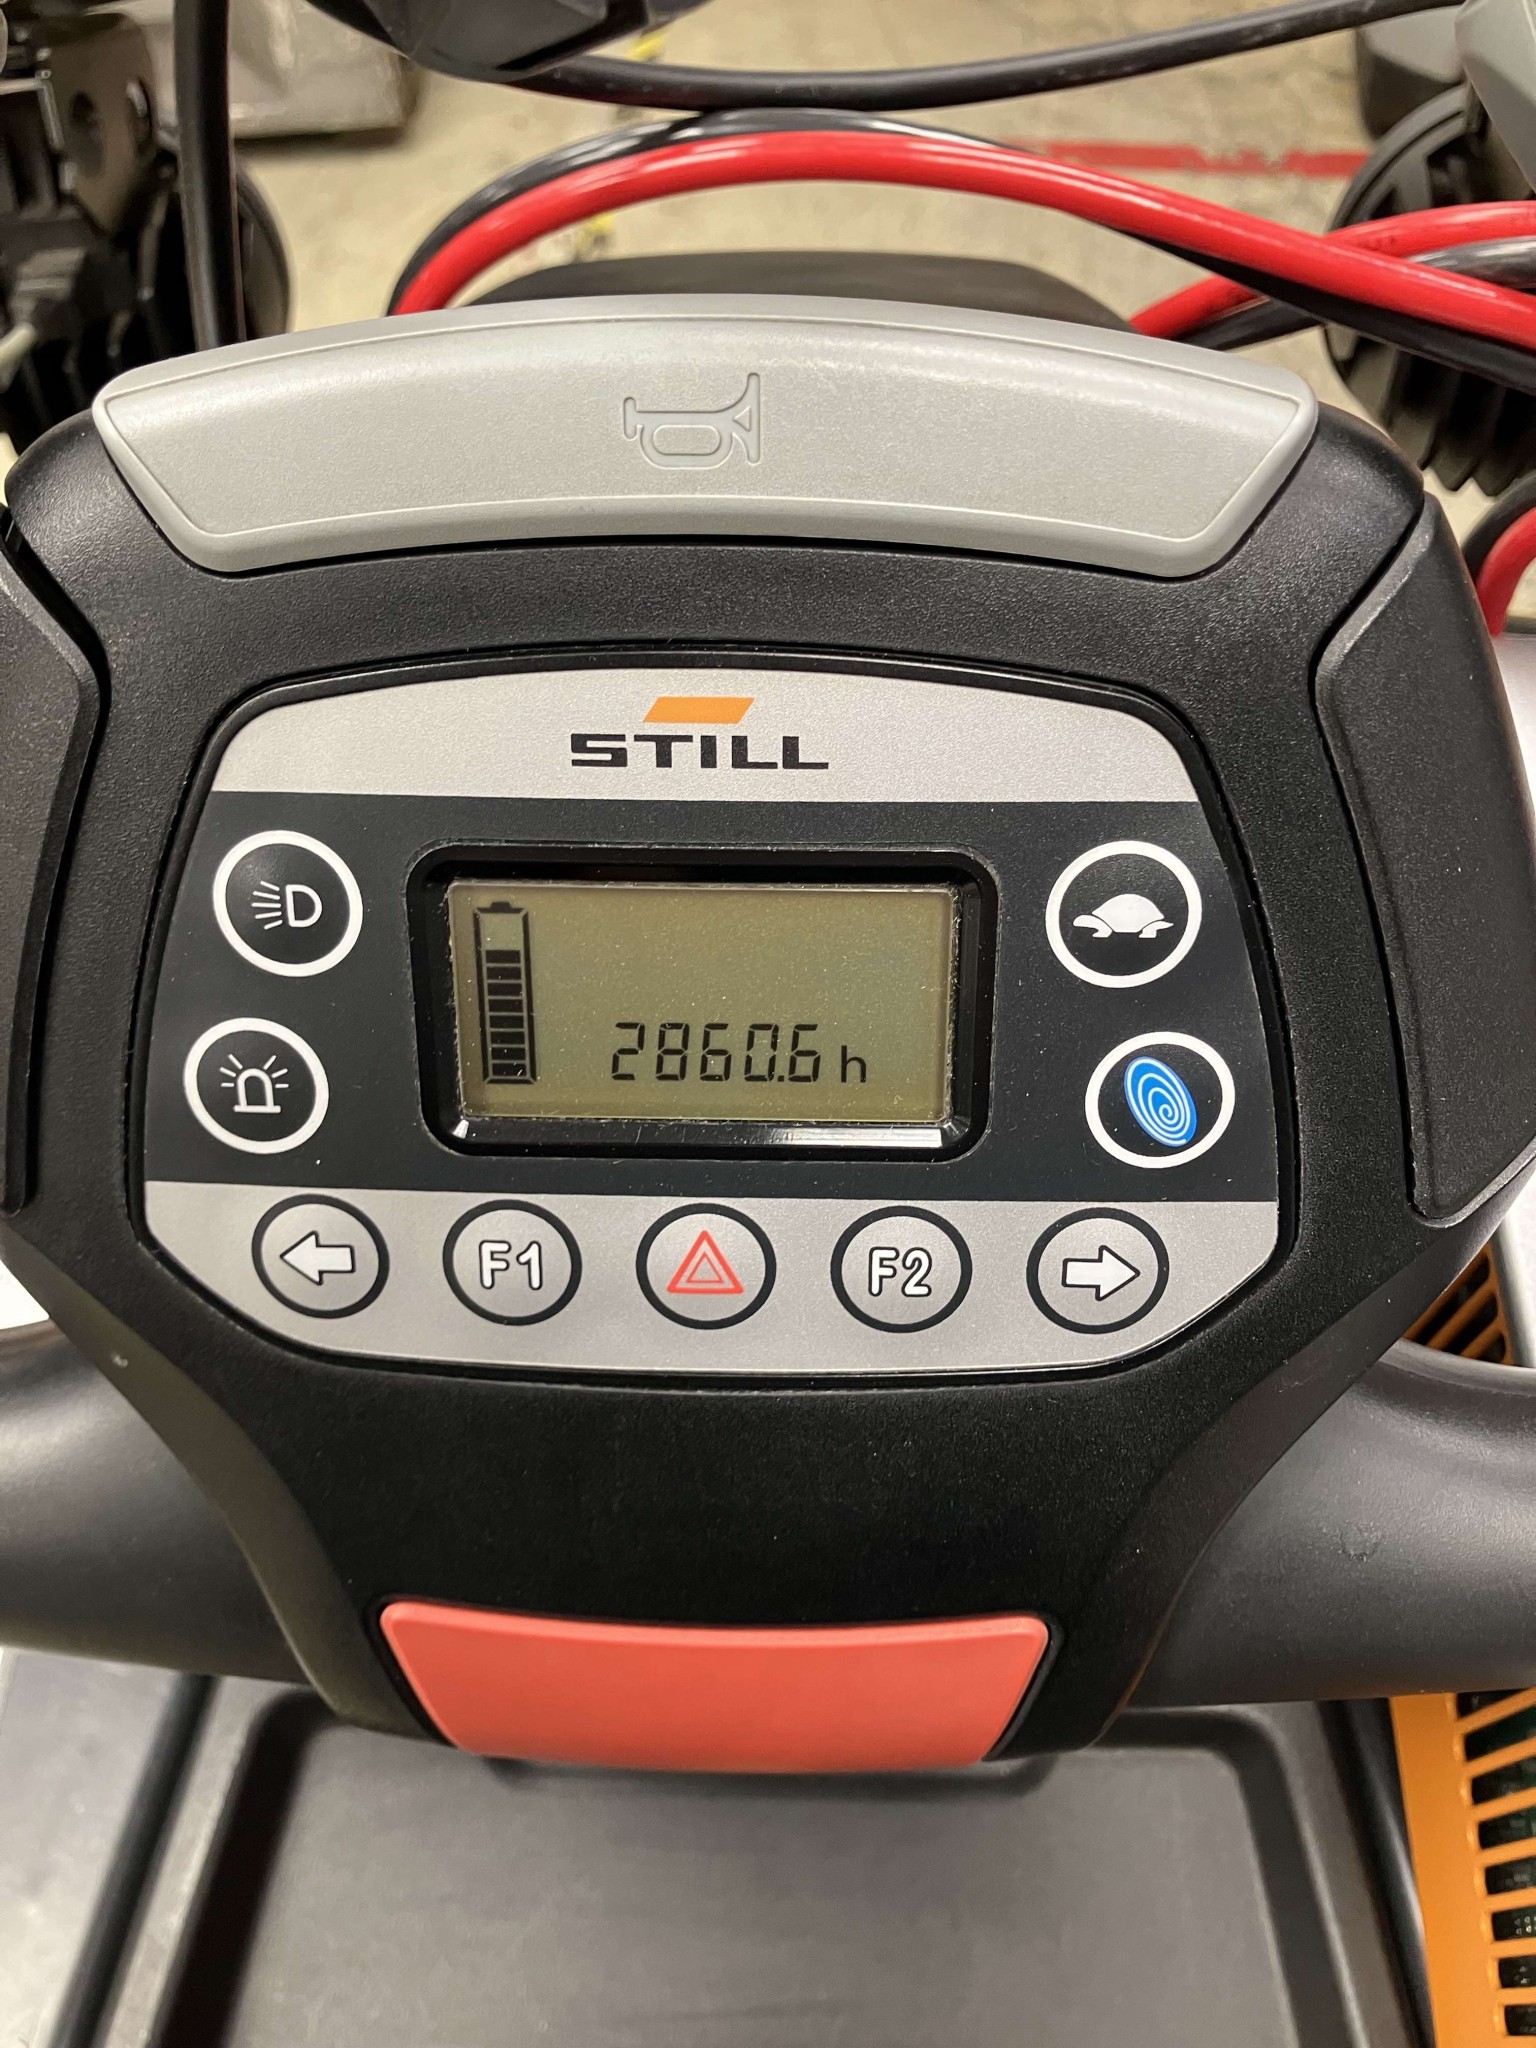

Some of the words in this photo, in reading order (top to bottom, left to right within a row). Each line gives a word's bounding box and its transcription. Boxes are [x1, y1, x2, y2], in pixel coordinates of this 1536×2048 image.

[571, 733, 829, 770] STILL
[611, 1022, 820, 1083] 2860.6
[840, 1045, 867, 1084] h
[477, 1240, 543, 1292] F1
[867, 1246, 933, 1298] F2
